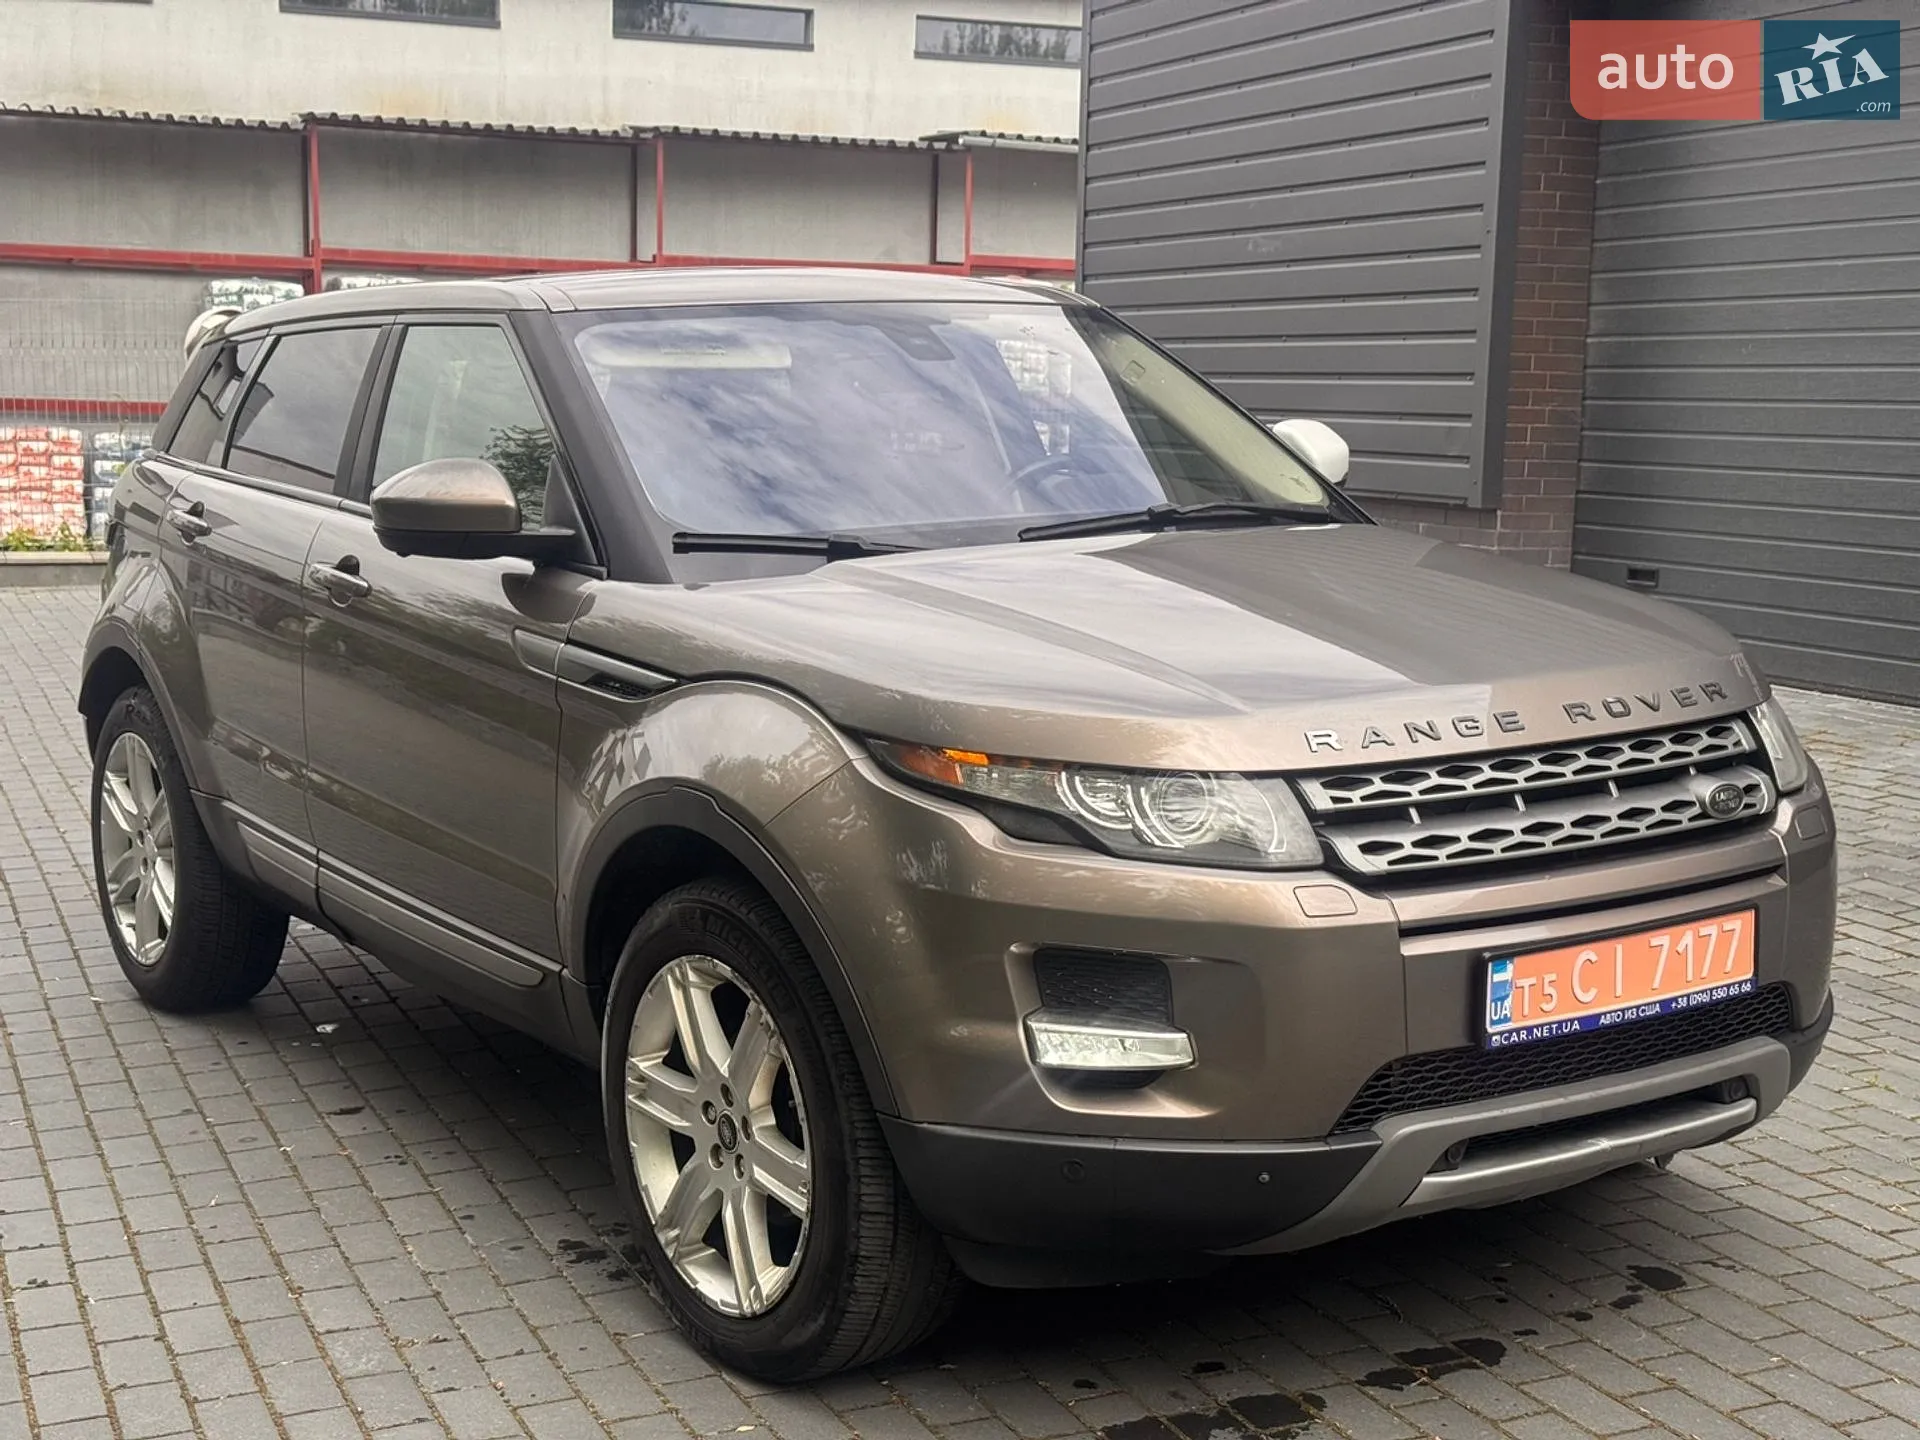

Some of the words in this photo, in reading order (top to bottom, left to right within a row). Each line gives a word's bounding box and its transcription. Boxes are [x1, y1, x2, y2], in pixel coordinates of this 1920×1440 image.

[1304, 711, 1525, 753] RANGE
[1562, 681, 1729, 724] ROVER
[1515, 973, 1558, 1017] T5
[1571, 943, 1624, 1004] CI
[1649, 919, 1743, 990] 7177
[1670, 997, 1688, 1010] +38
[1689, 991, 1711, 1005] (096)
[1711, 986, 1728, 1000] 550
[1729, 984, 1740, 996] 65
[1491, 1001, 1510, 1020] UA
[1599, 1011, 1622, 1026] АВТО
[1624, 1008, 1637, 1020] ИЗ
[1638, 1003, 1661, 1017] США
